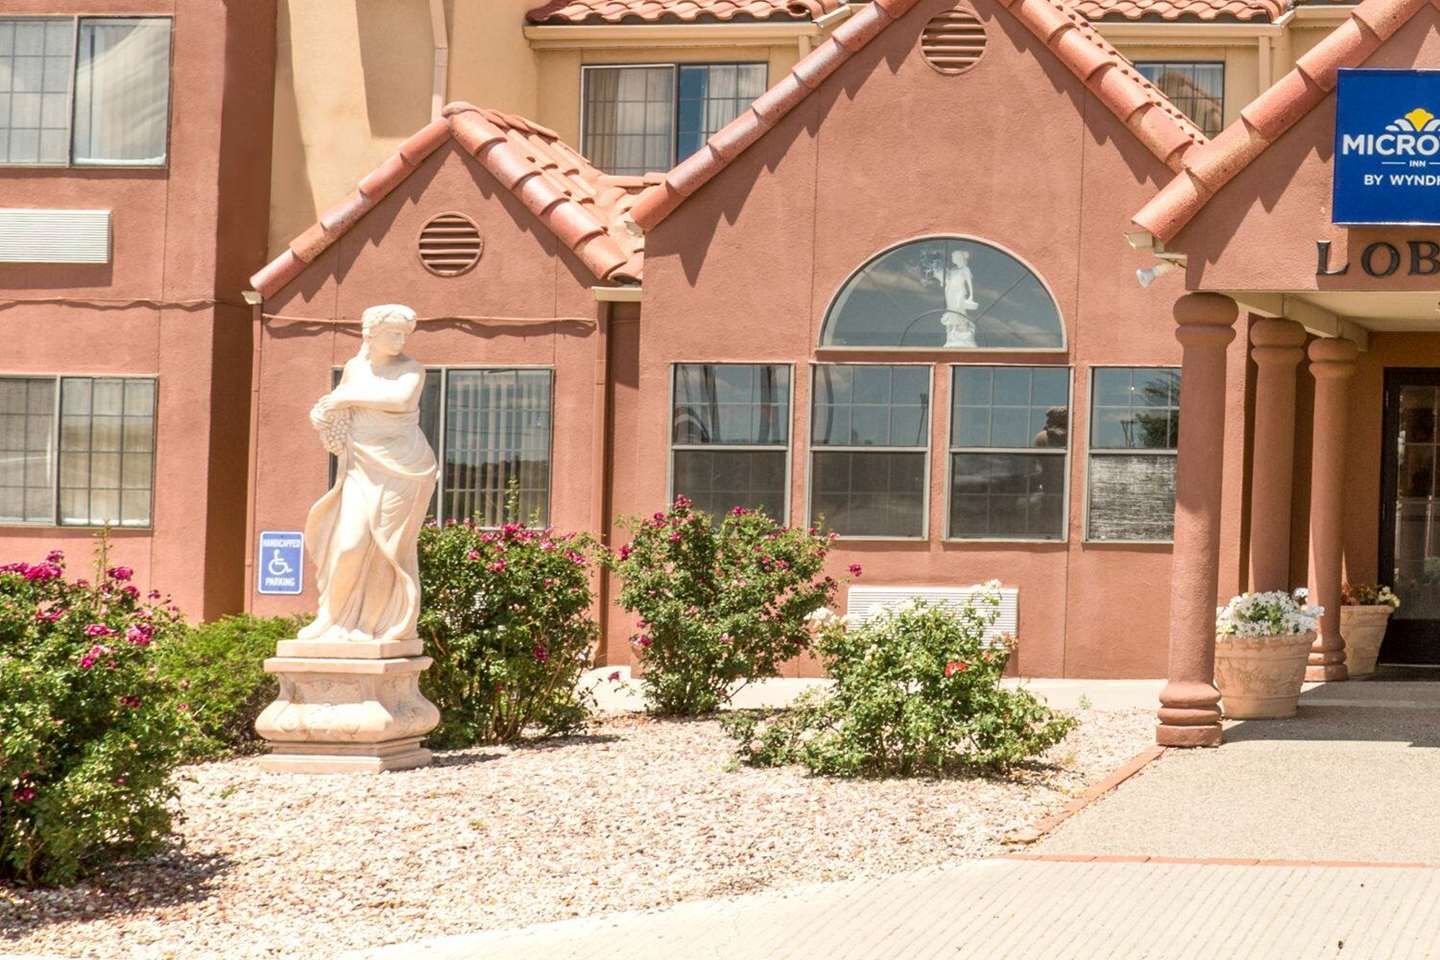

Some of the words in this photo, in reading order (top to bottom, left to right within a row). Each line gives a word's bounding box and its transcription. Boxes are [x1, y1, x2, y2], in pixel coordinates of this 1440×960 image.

[1409, 160, 1427, 168] INN
[1364, 174, 1383, 186] BY
[265, 577, 296, 587] PARKING
